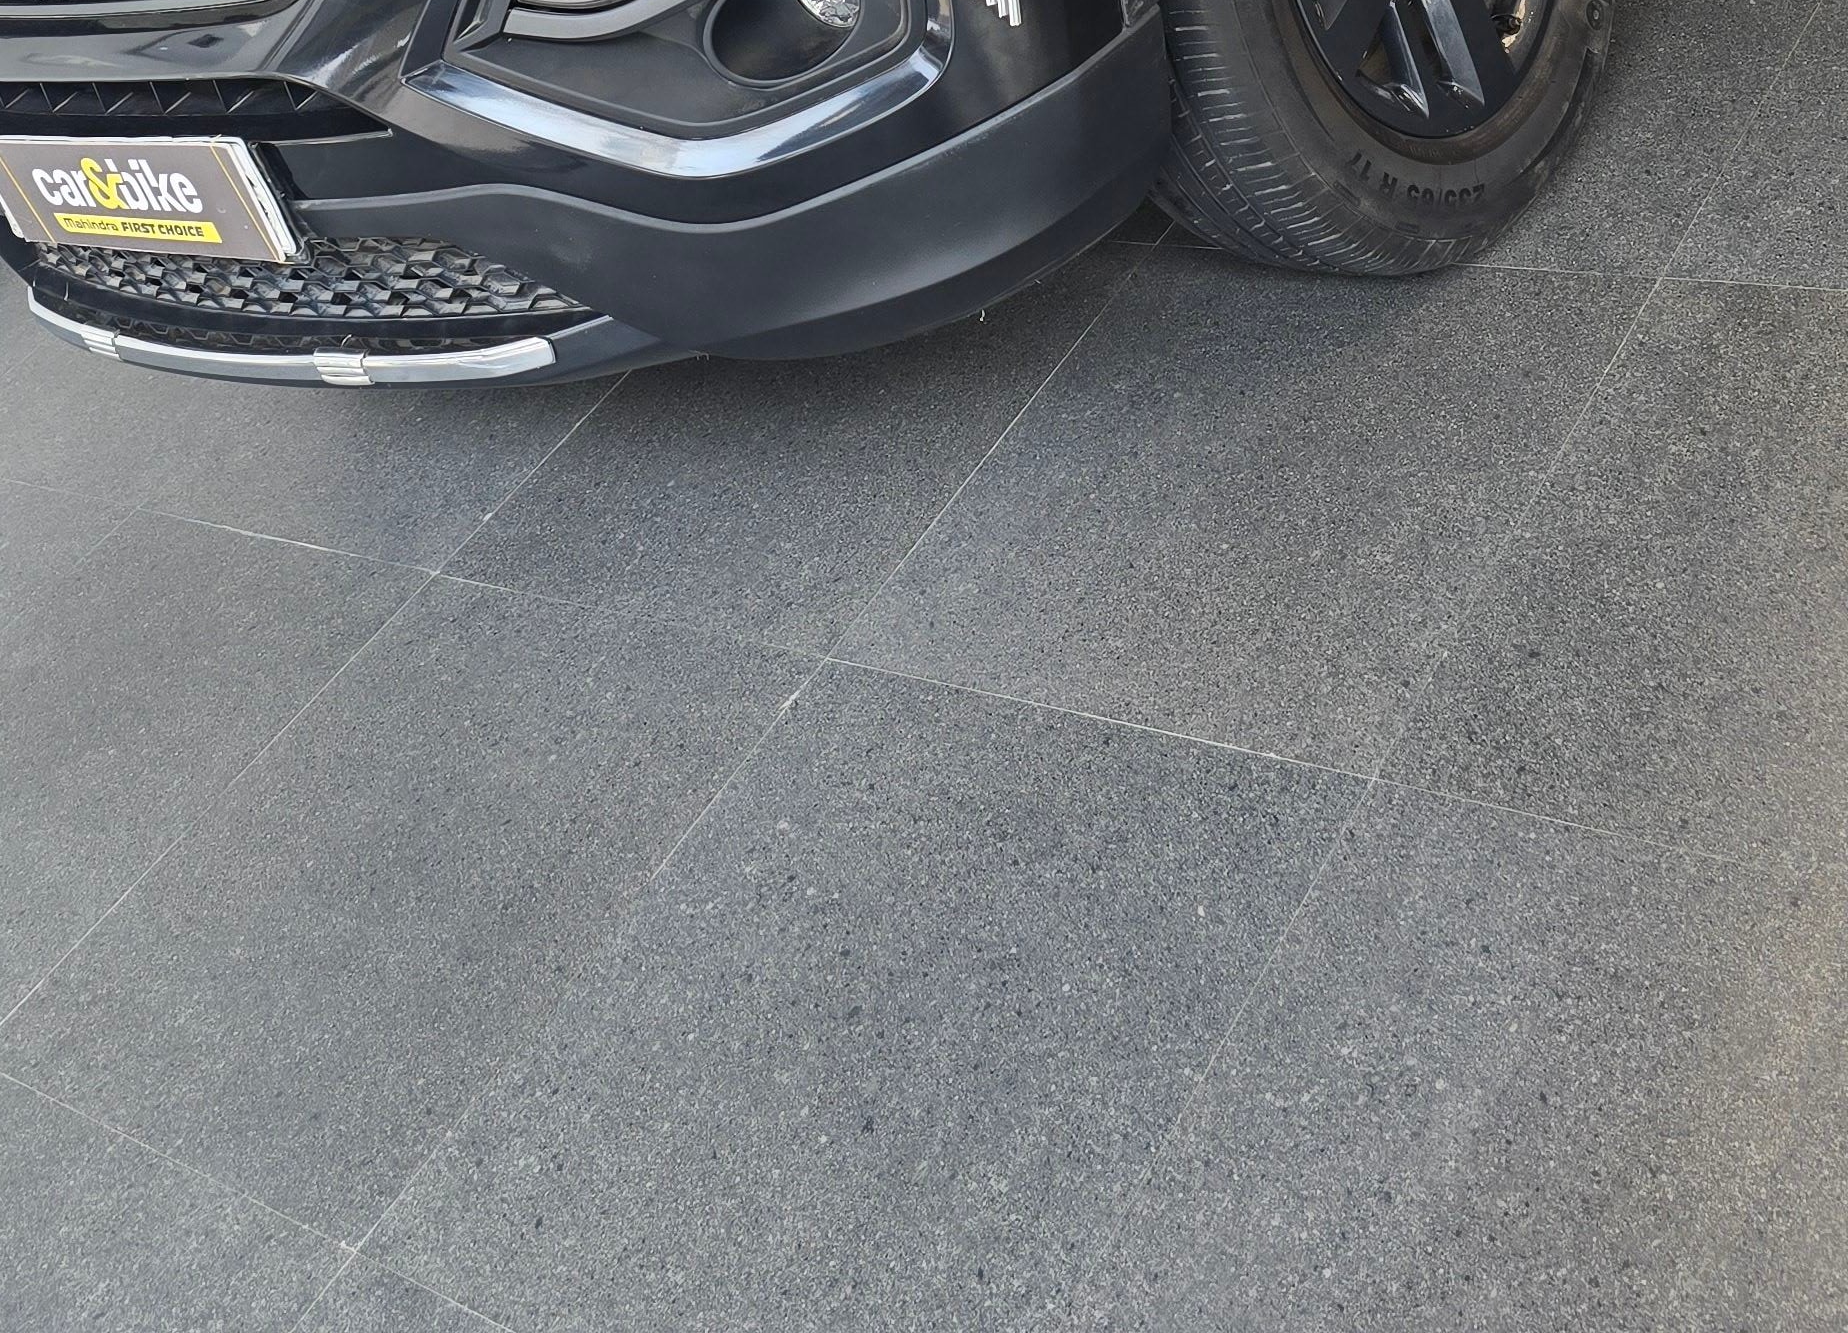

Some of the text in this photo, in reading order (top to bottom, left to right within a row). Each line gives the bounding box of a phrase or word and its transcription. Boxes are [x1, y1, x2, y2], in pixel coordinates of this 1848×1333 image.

[32, 157, 203, 214] car&bike
[63, 217, 204, 238] Mahindra FIRST CHOICE
